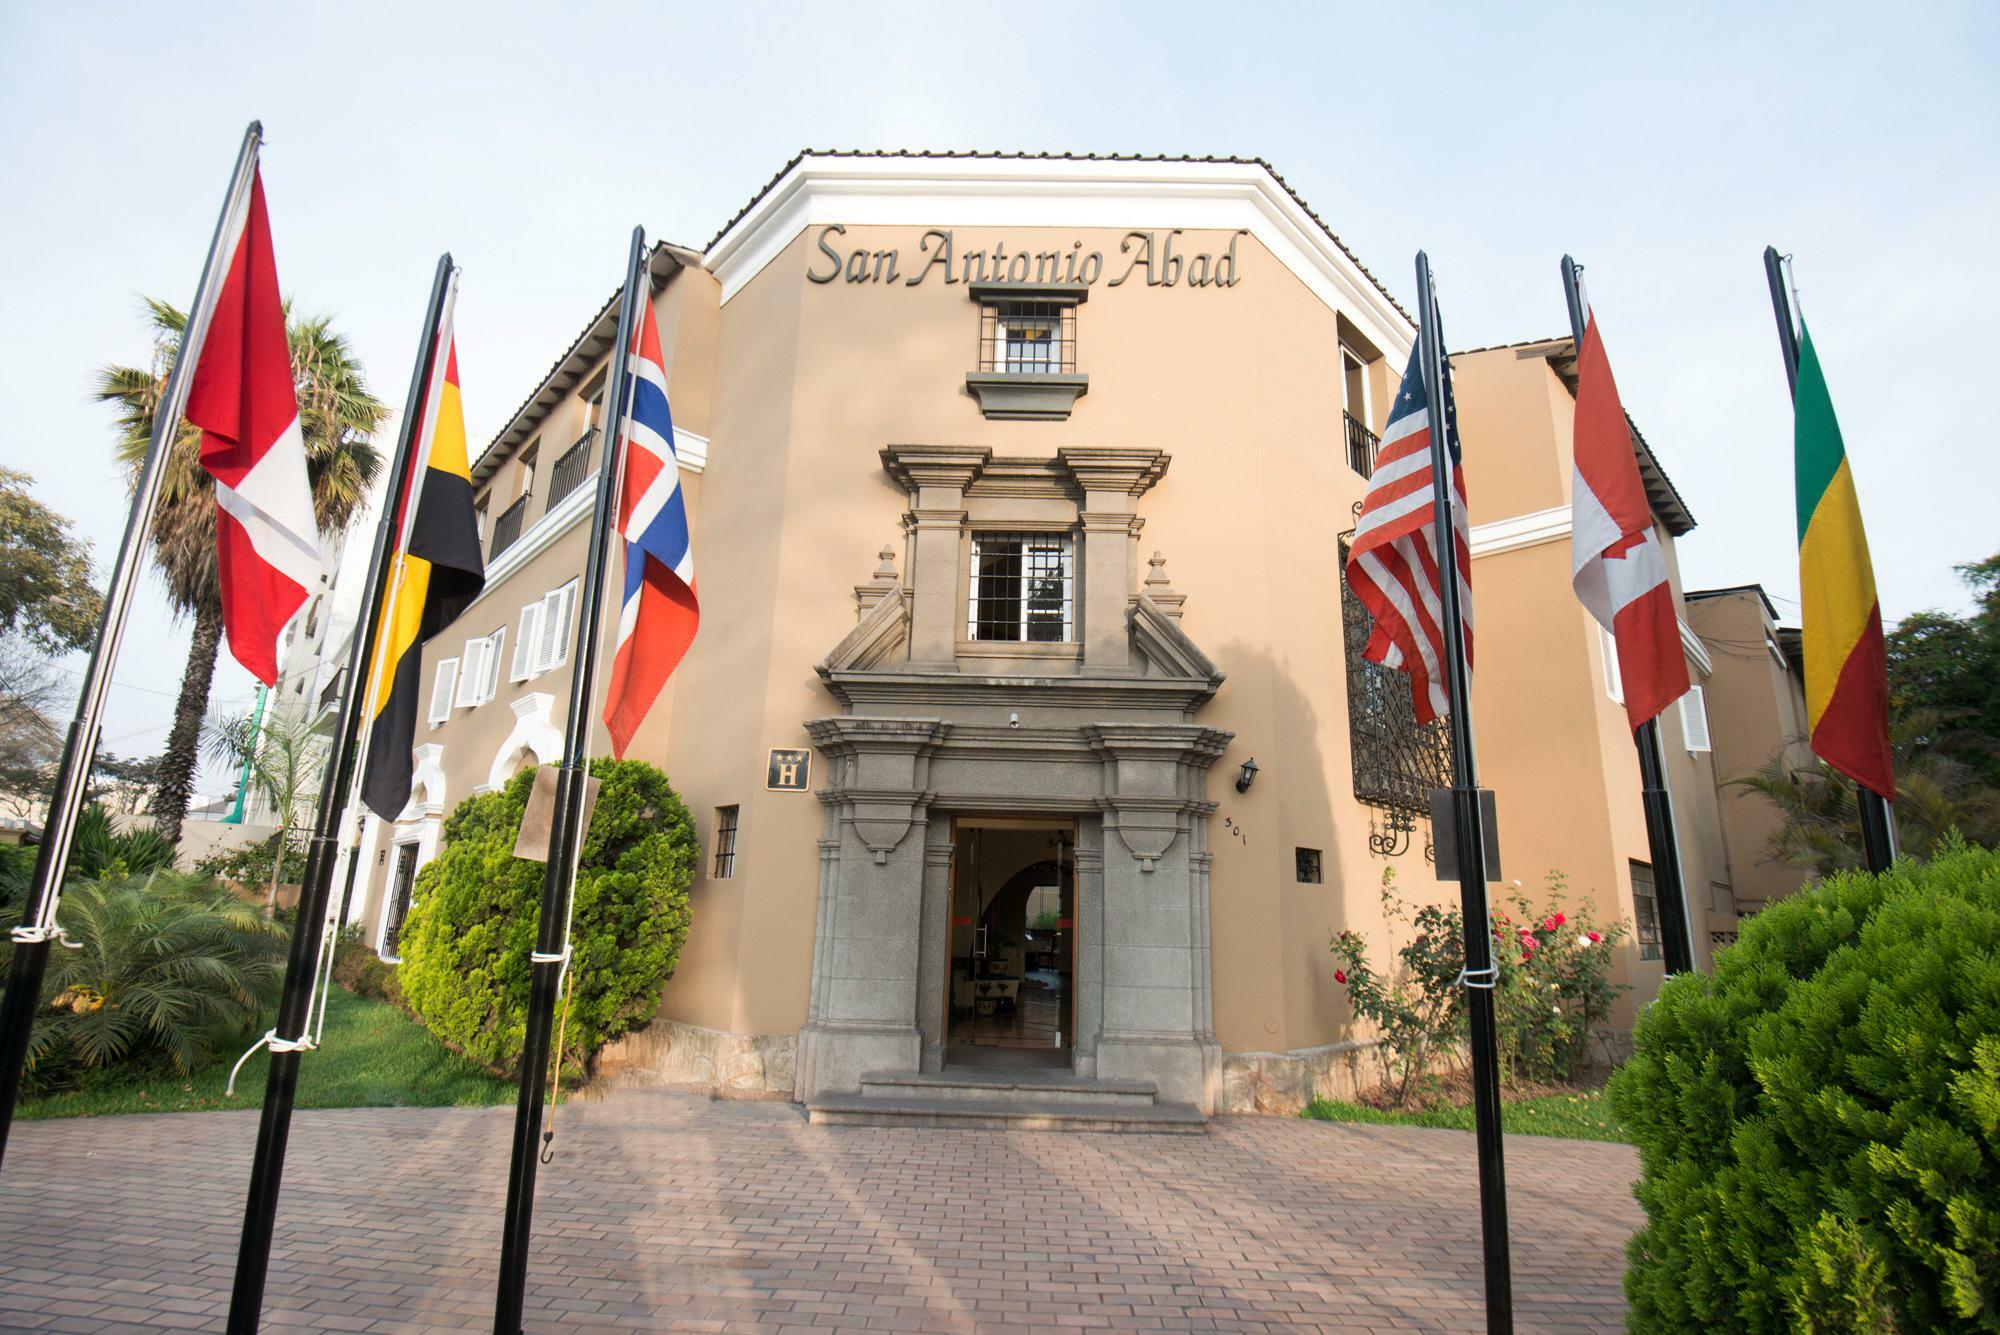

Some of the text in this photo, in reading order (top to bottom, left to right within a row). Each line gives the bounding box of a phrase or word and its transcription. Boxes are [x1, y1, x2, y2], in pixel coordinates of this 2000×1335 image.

[806, 223, 1247, 288] San Antonio Abad
[777, 764, 798, 785] H
